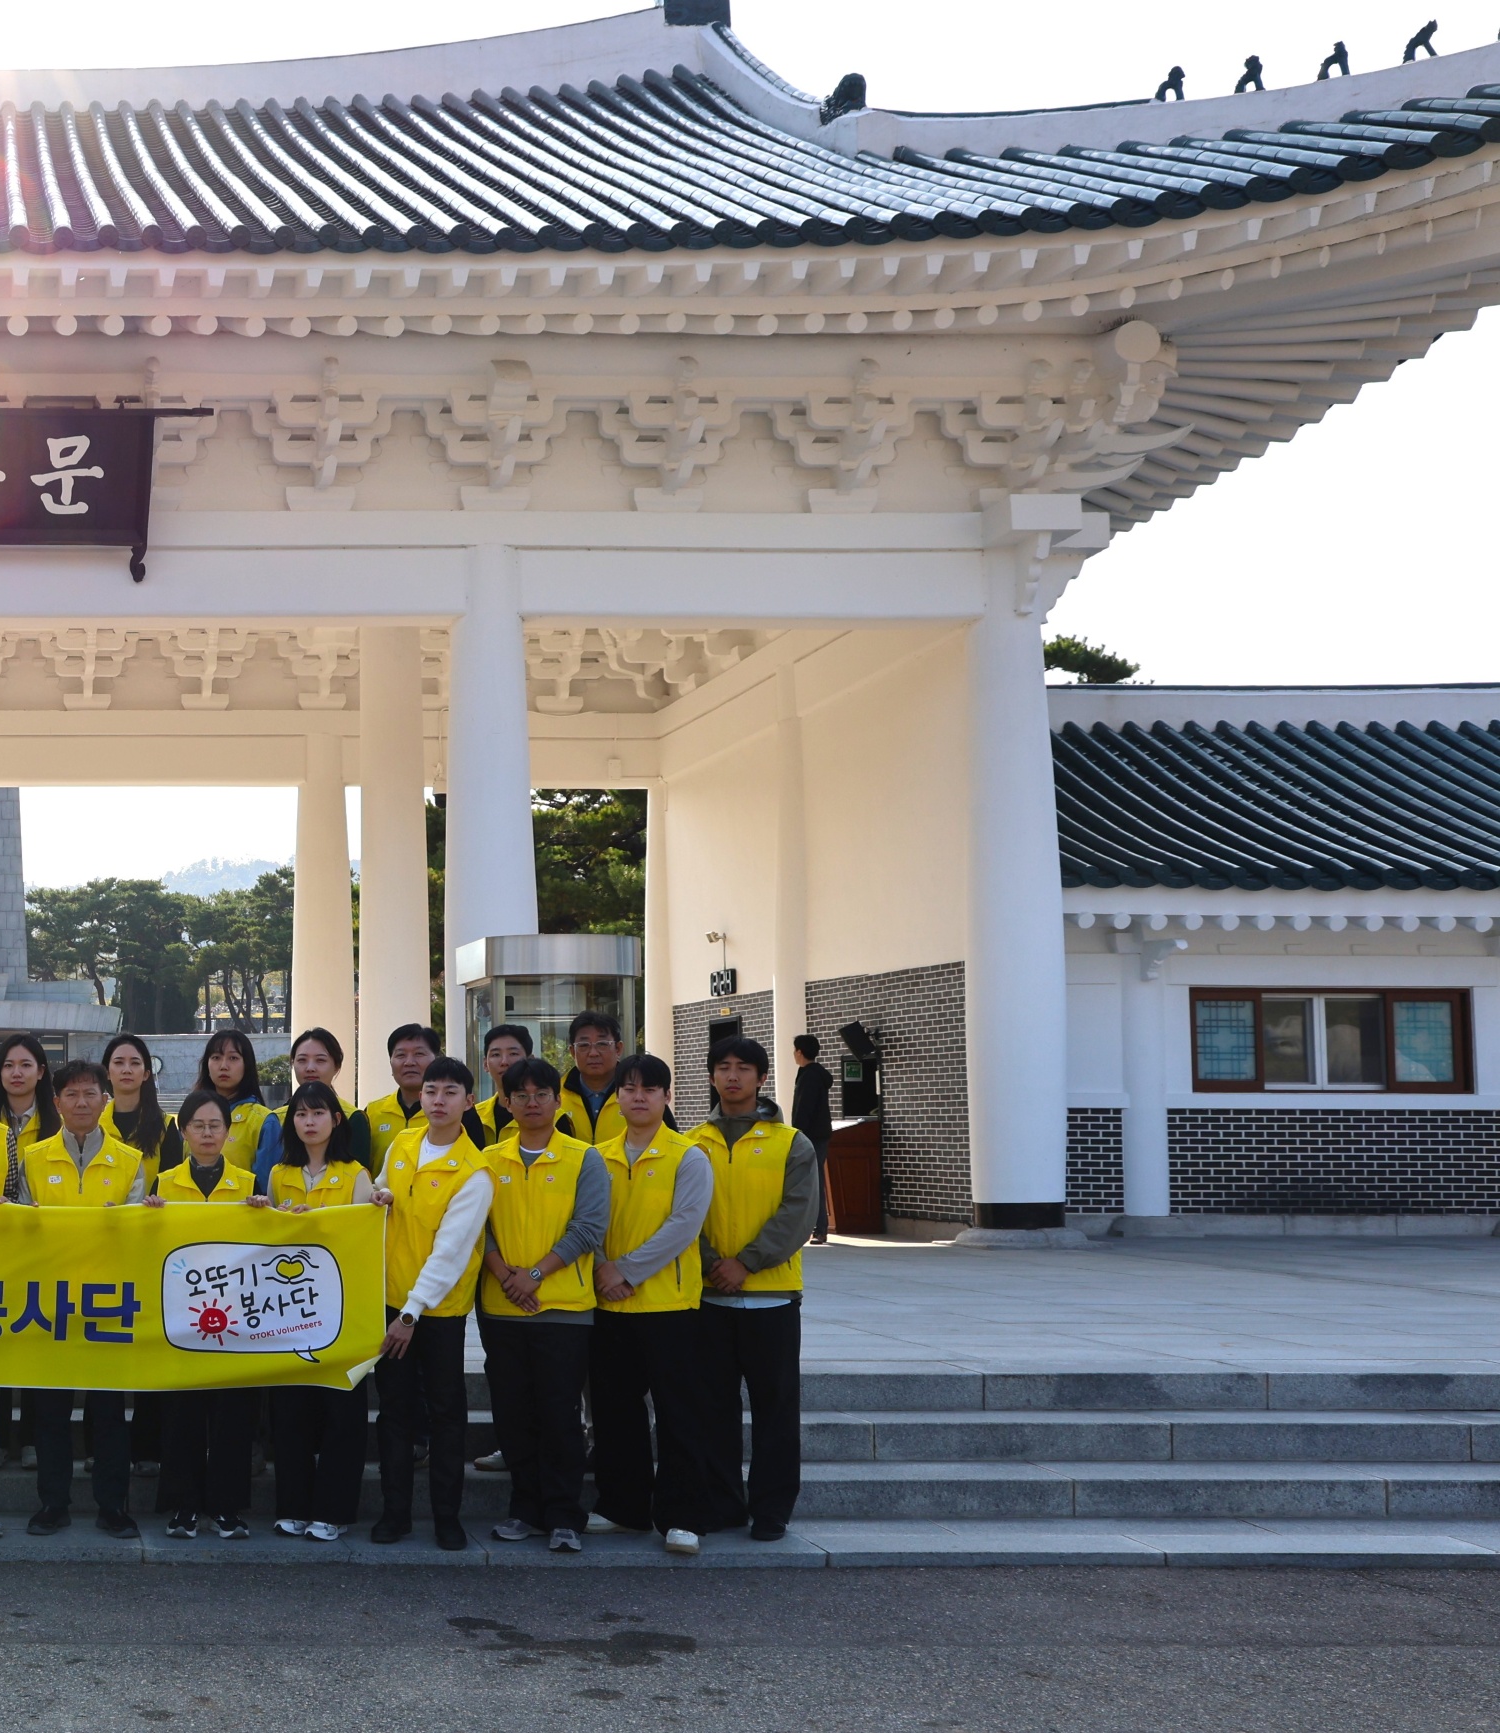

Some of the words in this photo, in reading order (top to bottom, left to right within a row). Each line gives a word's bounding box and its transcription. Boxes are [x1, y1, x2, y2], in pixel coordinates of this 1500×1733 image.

[185, 1263, 258, 1298] 오뚜기
[240, 1286, 319, 1329] 봉사단
[250, 1330, 275, 1341] OTOKI
[276, 1320, 323, 1335] Volunteers
